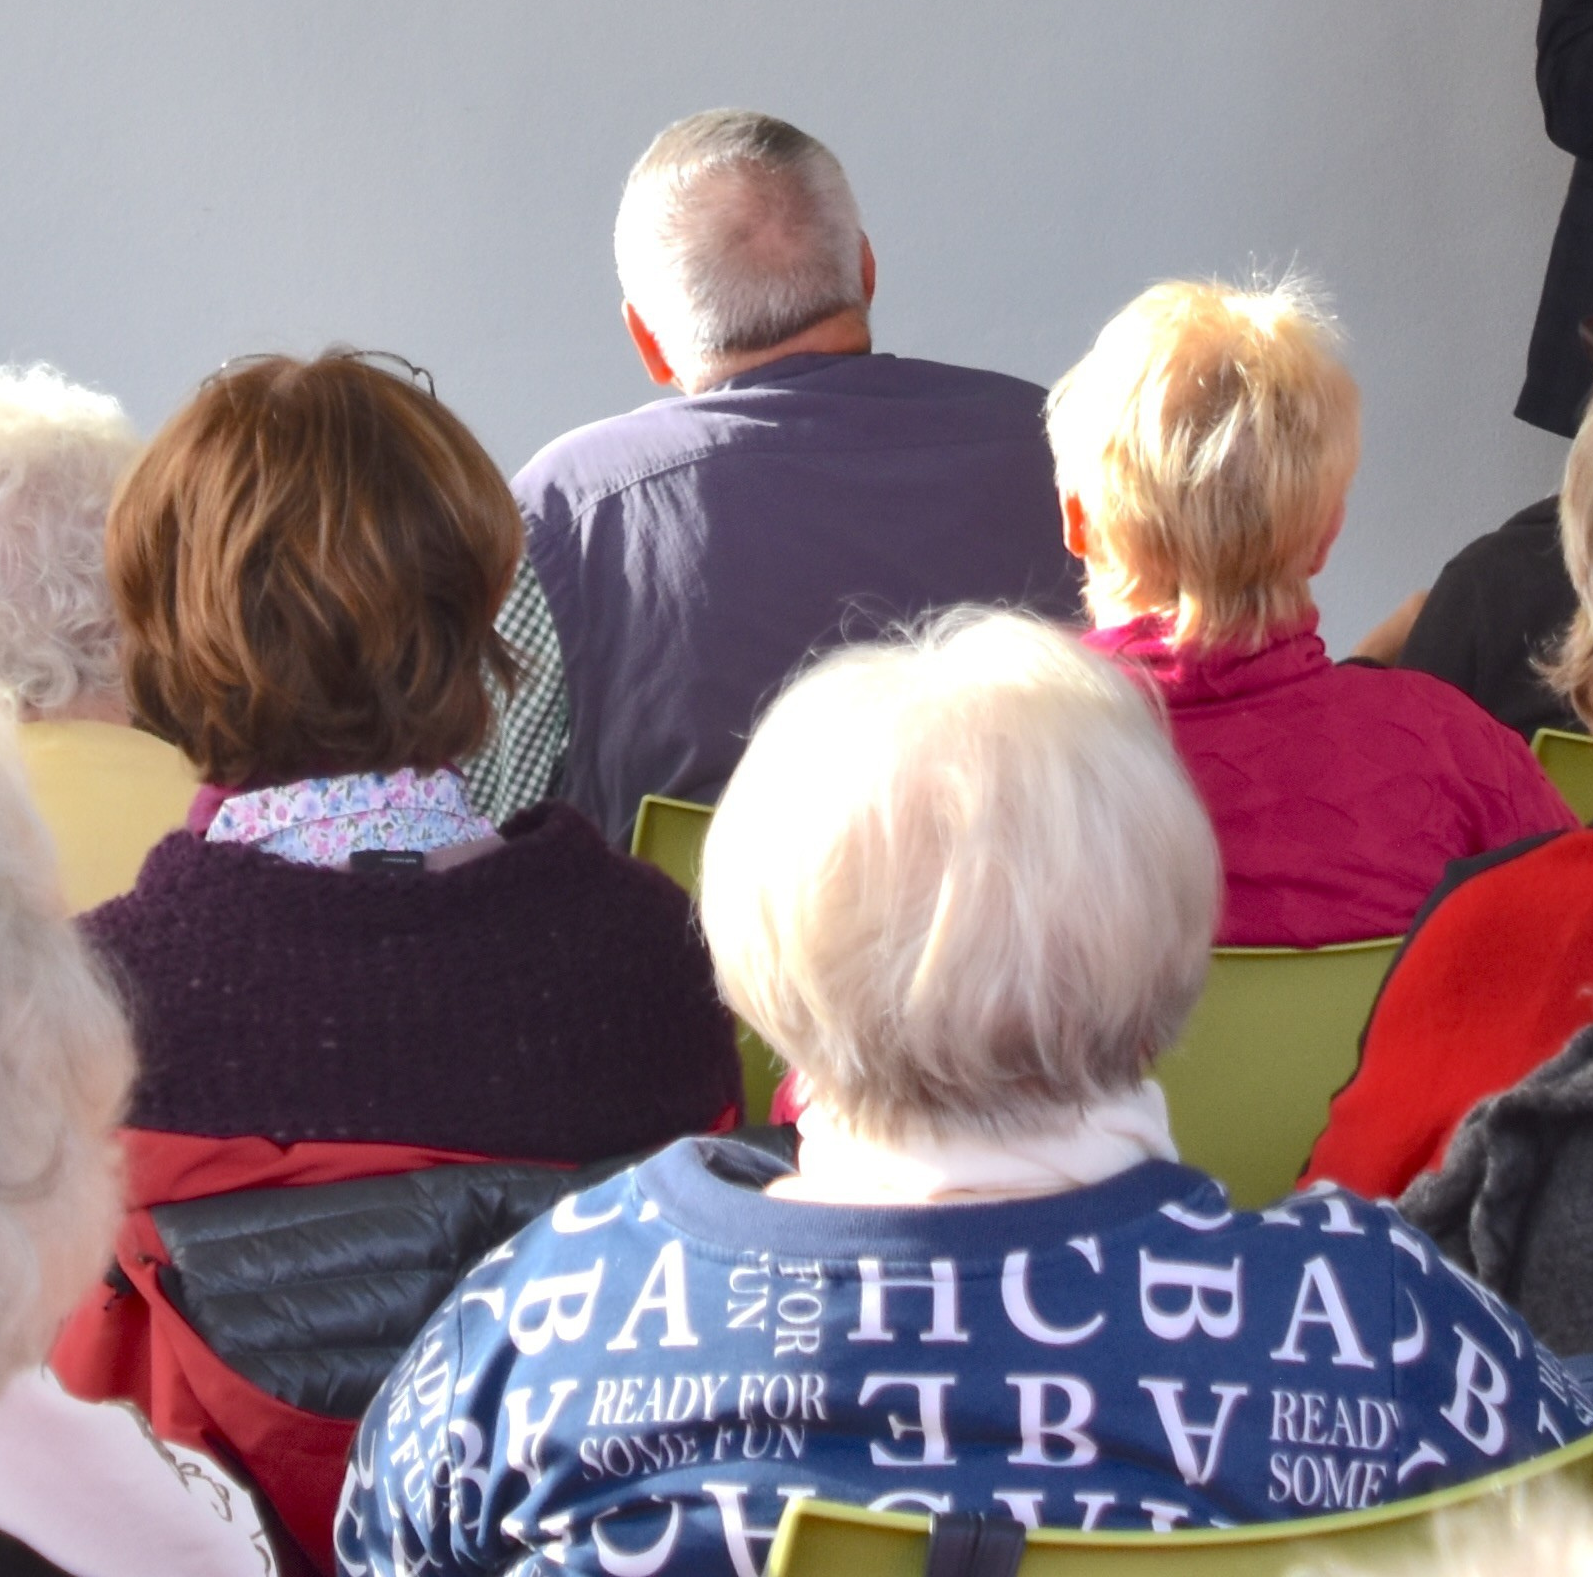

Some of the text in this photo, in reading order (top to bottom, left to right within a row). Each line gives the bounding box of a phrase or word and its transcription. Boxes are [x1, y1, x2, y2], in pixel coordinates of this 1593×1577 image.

[774, 1261, 822, 1358] FOR
[588, 1374, 827, 1426] READY FOR
[579, 1423, 806, 1480] SOME FUN
[1269, 1452, 1387, 1508] SOME
